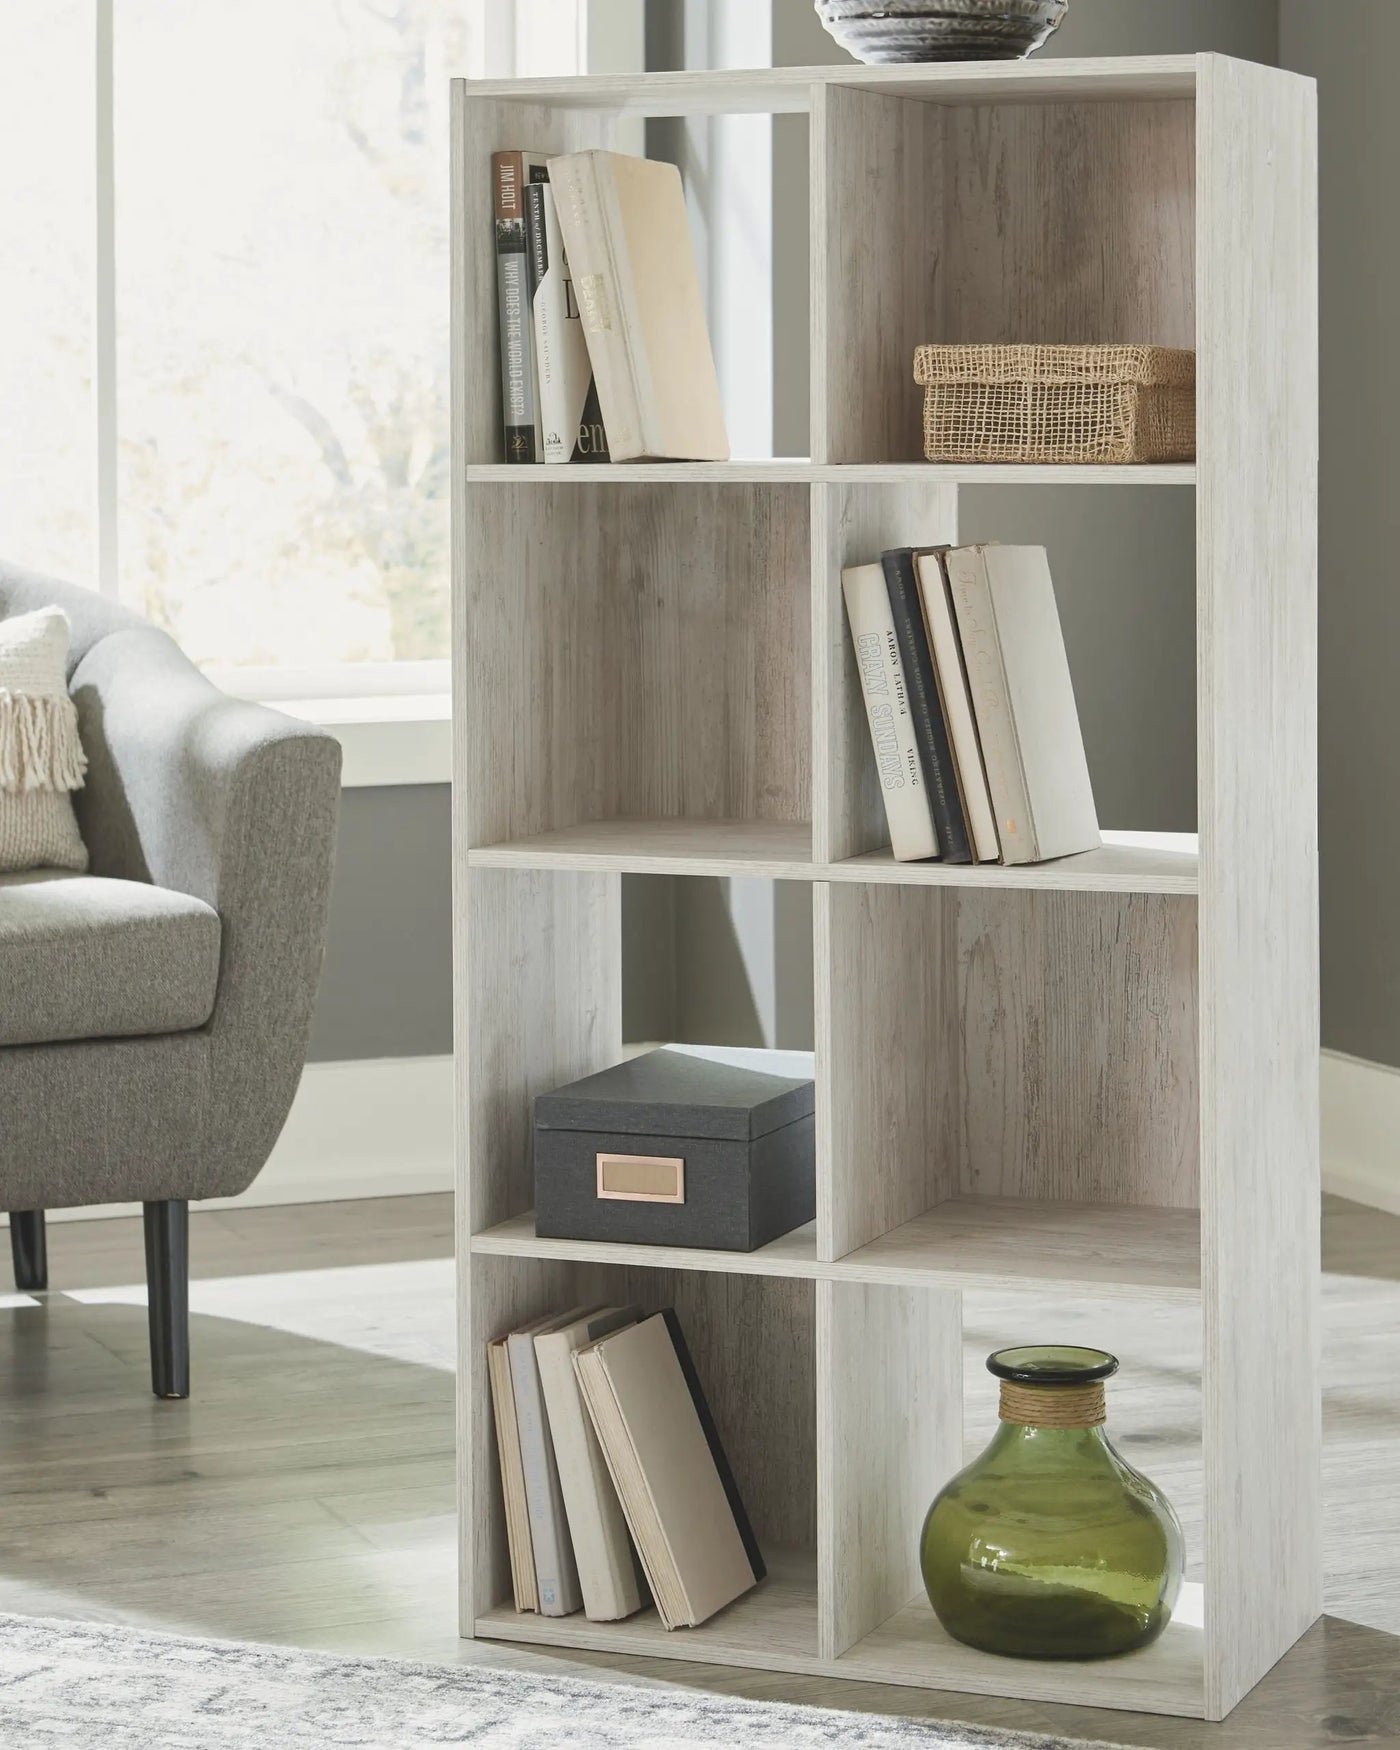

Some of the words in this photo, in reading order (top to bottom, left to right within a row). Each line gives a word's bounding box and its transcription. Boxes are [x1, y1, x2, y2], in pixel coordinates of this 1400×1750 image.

[500, 164, 515, 182] JIM
[501, 185, 516, 210] HOLT
[532, 192, 541, 221] TENTH
[504, 260, 518, 285] WHY
[505, 286, 520, 315] DOES
[506, 317, 521, 338] THE
[508, 339, 522, 378] WORLD
[543, 340, 551, 385] SAUNDERS
[509, 380, 525, 416] EXIST?
[856, 632, 890, 696] CRAZY
[885, 629, 899, 666] AARON
[893, 672, 908, 716] LATHAM
[870, 703, 906, 790] SUNDAYS
[906, 748, 920, 786] VIKING
[929, 754, 945, 806] OPERATING
